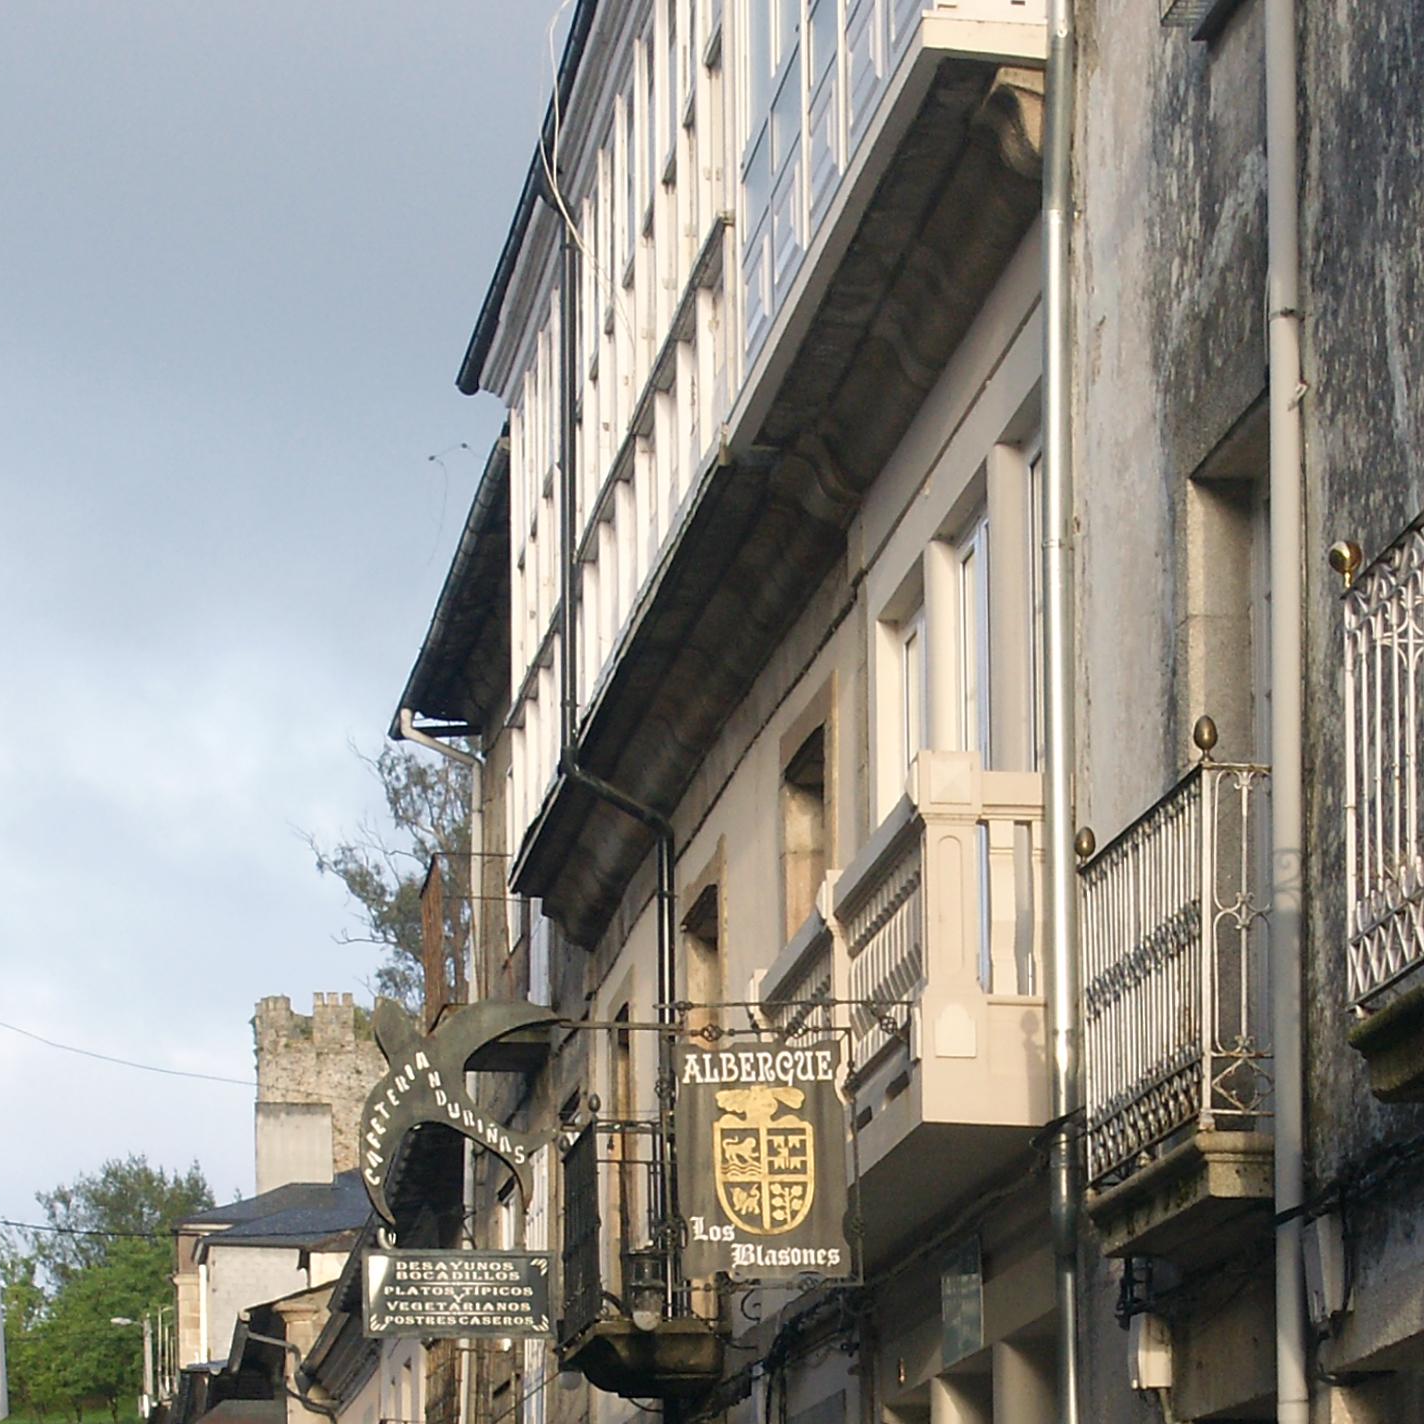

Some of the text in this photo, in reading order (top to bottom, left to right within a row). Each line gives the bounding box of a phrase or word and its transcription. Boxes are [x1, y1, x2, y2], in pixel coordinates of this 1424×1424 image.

[682, 1050, 833, 1087] ALBERGUE
[364, 1052, 430, 1185] CAFETERIA
[690, 1216, 736, 1241] Los
[731, 1243, 840, 1268] Blasones
[396, 1261, 514, 1271] DESAYUNOS
[396, 1271, 520, 1280] BOCADILLOS
[384, 1286, 455, 1296] PLATOS
[386, 1302, 531, 1312] VEGETARIANOS
[385, 1316, 534, 1326] POSTRES CASEROS
